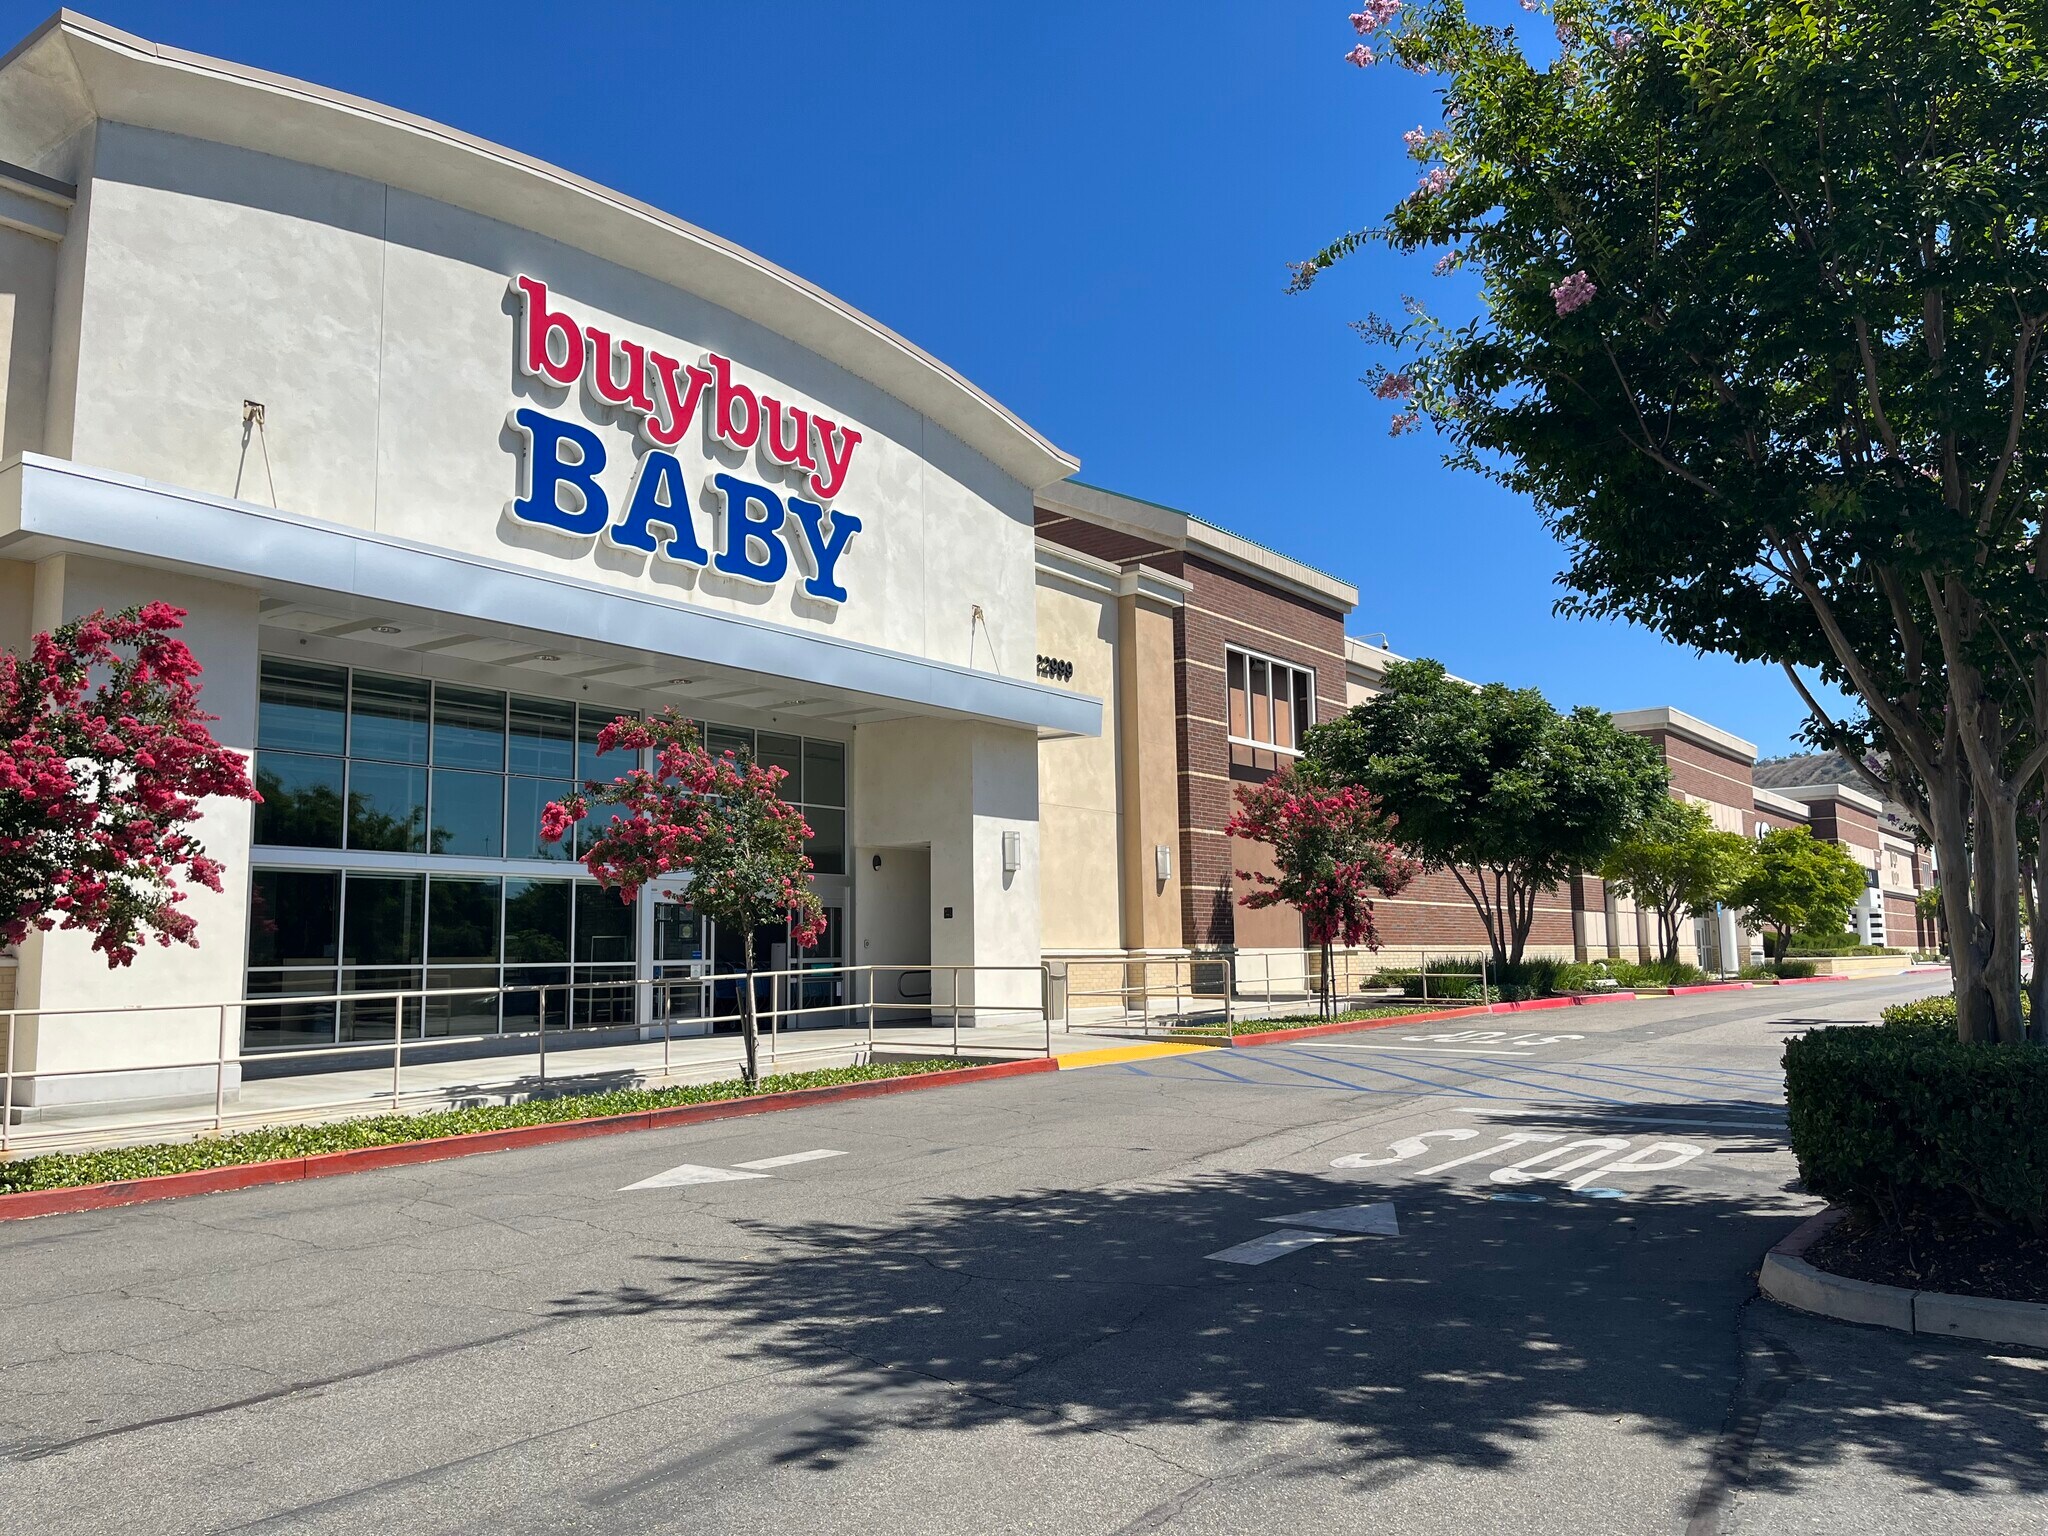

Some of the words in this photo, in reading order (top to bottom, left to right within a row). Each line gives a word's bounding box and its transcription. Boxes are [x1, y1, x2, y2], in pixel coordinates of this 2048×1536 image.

[507, 407, 863, 604] BABY
[1401, 1030, 1585, 1046] STOP
[1330, 1128, 1705, 1191] STOP
